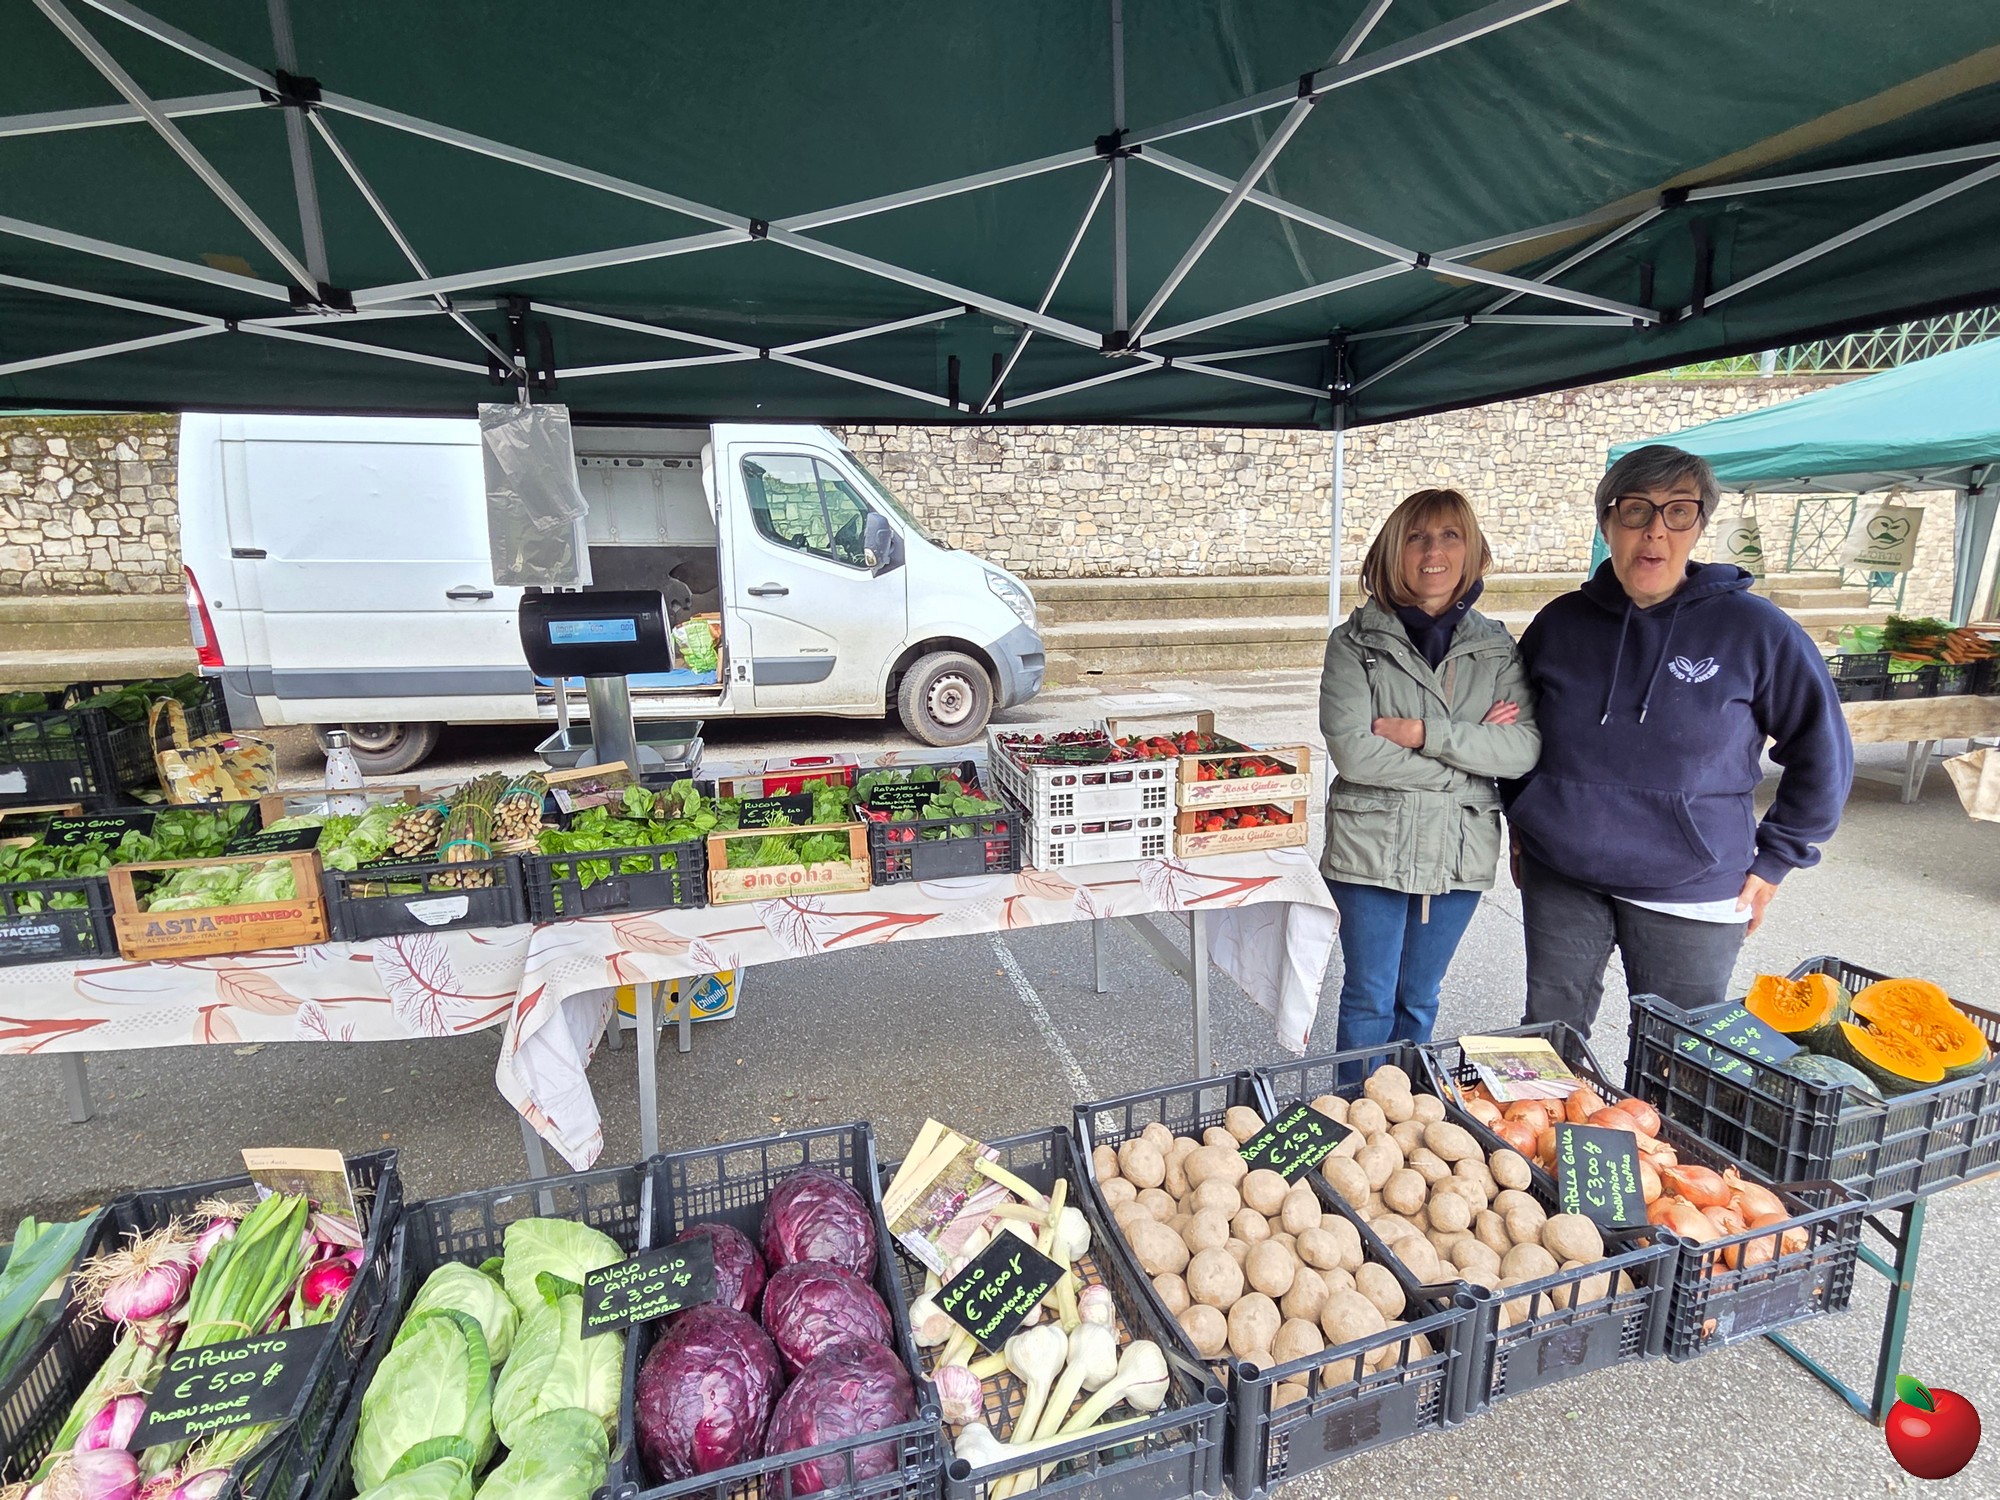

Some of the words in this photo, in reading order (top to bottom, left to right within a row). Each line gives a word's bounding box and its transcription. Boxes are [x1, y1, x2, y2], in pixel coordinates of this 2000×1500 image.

[1222, 783, 1249, 793] Rossi
[1251, 780, 1280, 793] Giulio
[747, 810, 759, 818] €
[63, 831, 81, 841] €
[1219, 833, 1245, 843] Rossi
[1247, 830, 1275, 841] Giulio
[744, 868, 833, 888] ancona
[0, 924, 60, 938] TACCHIO
[145, 917, 218, 937] ASTA
[214, 909, 302, 925] FRUTTALTEDO
[147, 936, 178, 944] ALTEDO
[201, 932, 222, 940] ITALY
[697, 986, 727, 1009] Chiquita
[1681, 1029, 1715, 1051] ZUA
[1712, 1009, 1748, 1030] DELICA
[1240, 1133, 1276, 1161] PATATE
[1276, 1107, 1308, 1133] GIALLE
[1270, 1147, 1286, 1164] €
[1283, 1132, 1309, 1151] 1,50
[1561, 1128, 1576, 1165] GIALLA
[1280, 1144, 1317, 1178] ODUZIONE
[1587, 1157, 1606, 1188] 3,00
[1564, 1168, 1580, 1215] CIPOLLA
[1586, 1190, 1605, 1207] €
[588, 1263, 640, 1286] CAVOLO
[604, 1259, 685, 1293] CAPPUCCIO
[598, 1296, 614, 1310] €
[627, 1282, 665, 1302] 3,00
[943, 1268, 985, 1312] AGLIO
[965, 1299, 982, 1320] €
[979, 1270, 1011, 1302] 15,00
[170, 1340, 287, 1372] CIPOLLOTTO
[174, 1375, 204, 1399] €
[208, 1372, 256, 1393] 5,00
